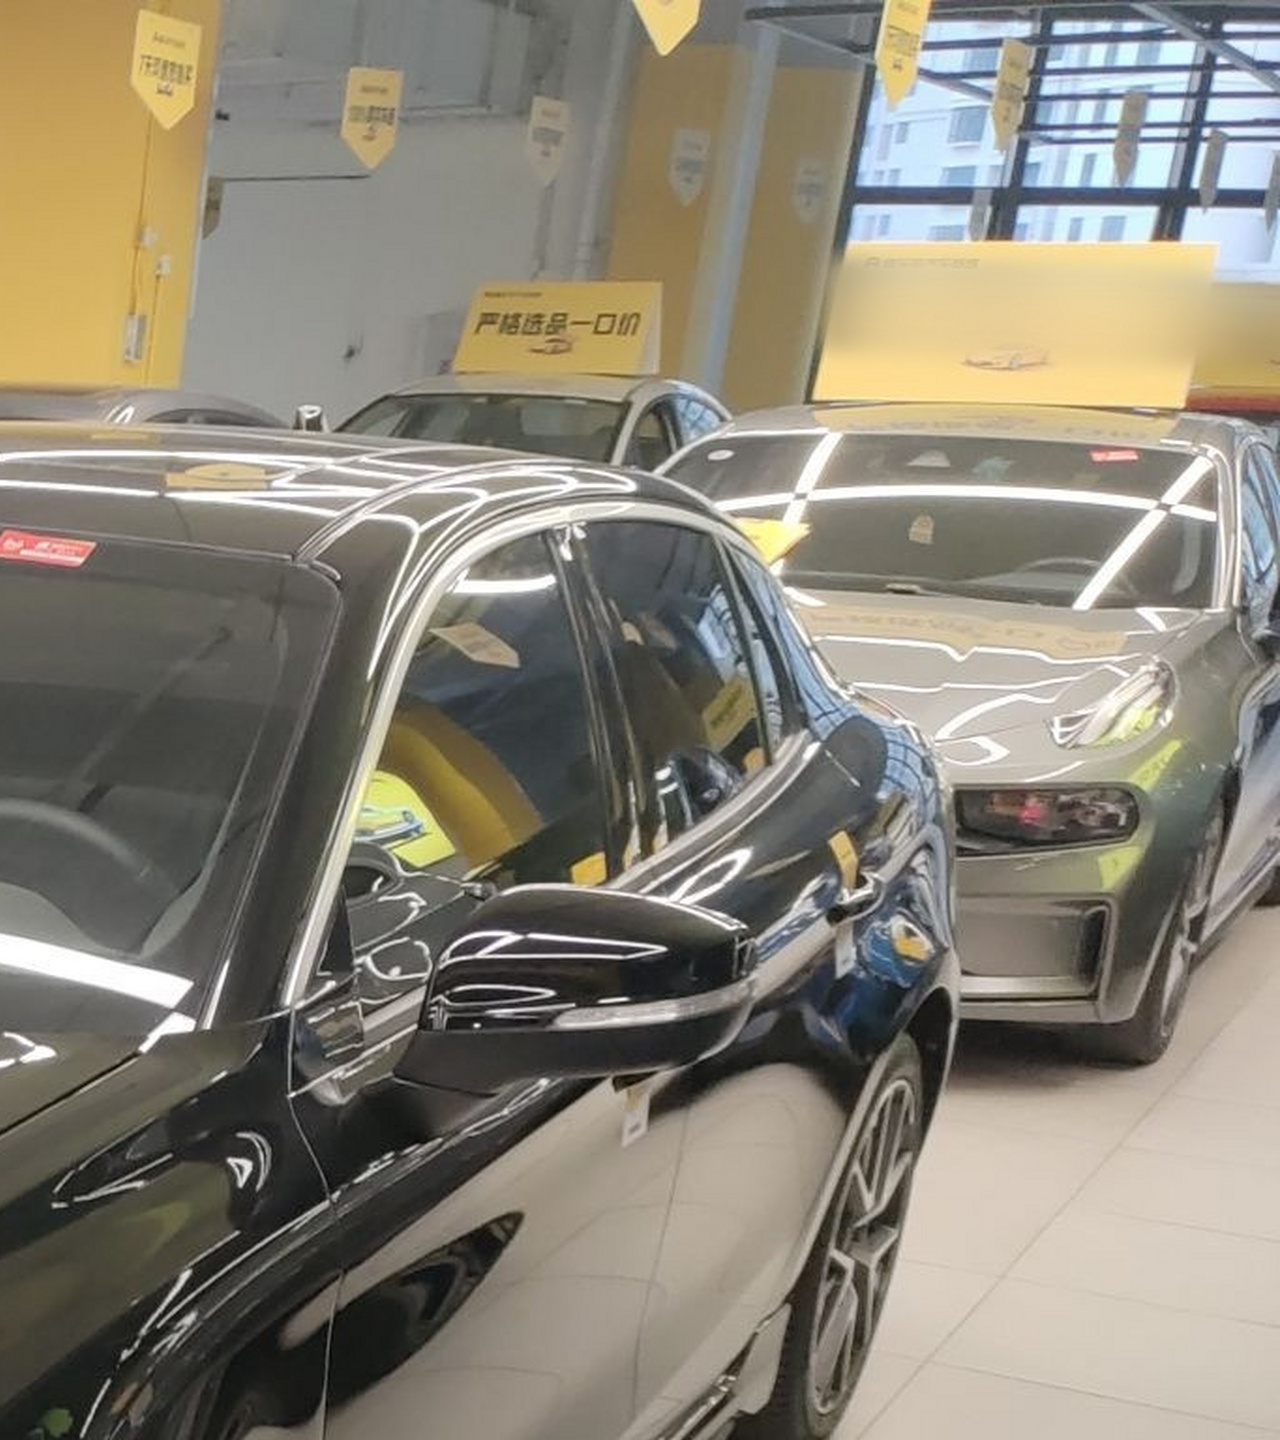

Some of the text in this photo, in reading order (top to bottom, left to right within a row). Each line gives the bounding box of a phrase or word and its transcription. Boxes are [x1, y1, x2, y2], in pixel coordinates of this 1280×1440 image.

[474, 312, 642, 337] 严格选品一口价
